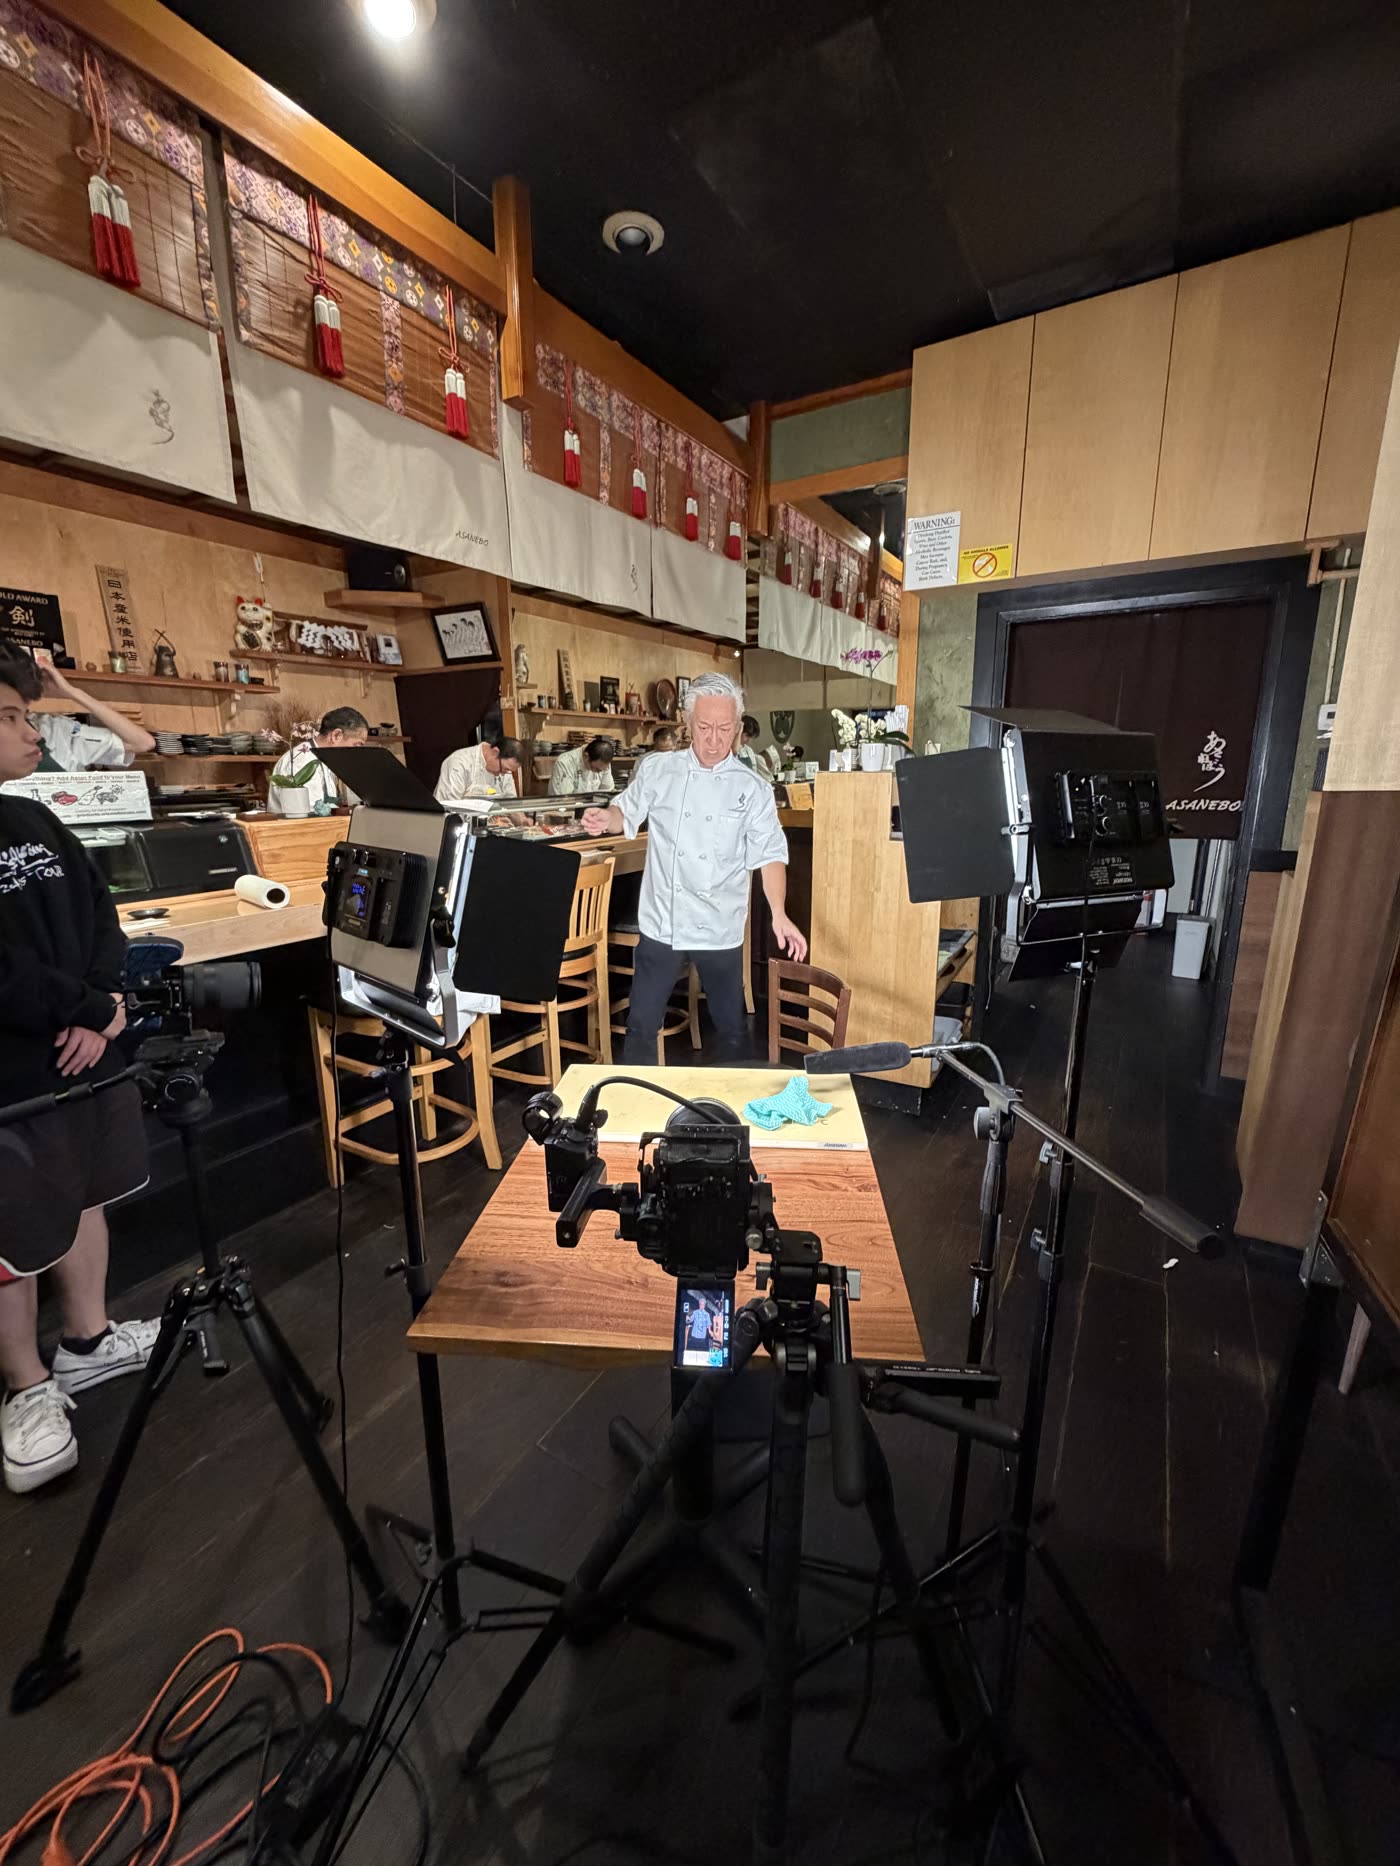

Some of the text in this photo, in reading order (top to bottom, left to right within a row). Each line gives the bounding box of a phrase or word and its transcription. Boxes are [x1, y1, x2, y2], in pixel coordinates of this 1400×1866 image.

[914, 517, 955, 530] WARNING:
[455, 531, 489, 546] ASANEBO
[16, 594, 48, 605] AWARD
[1165, 799, 1242, 812] ASANEBO
